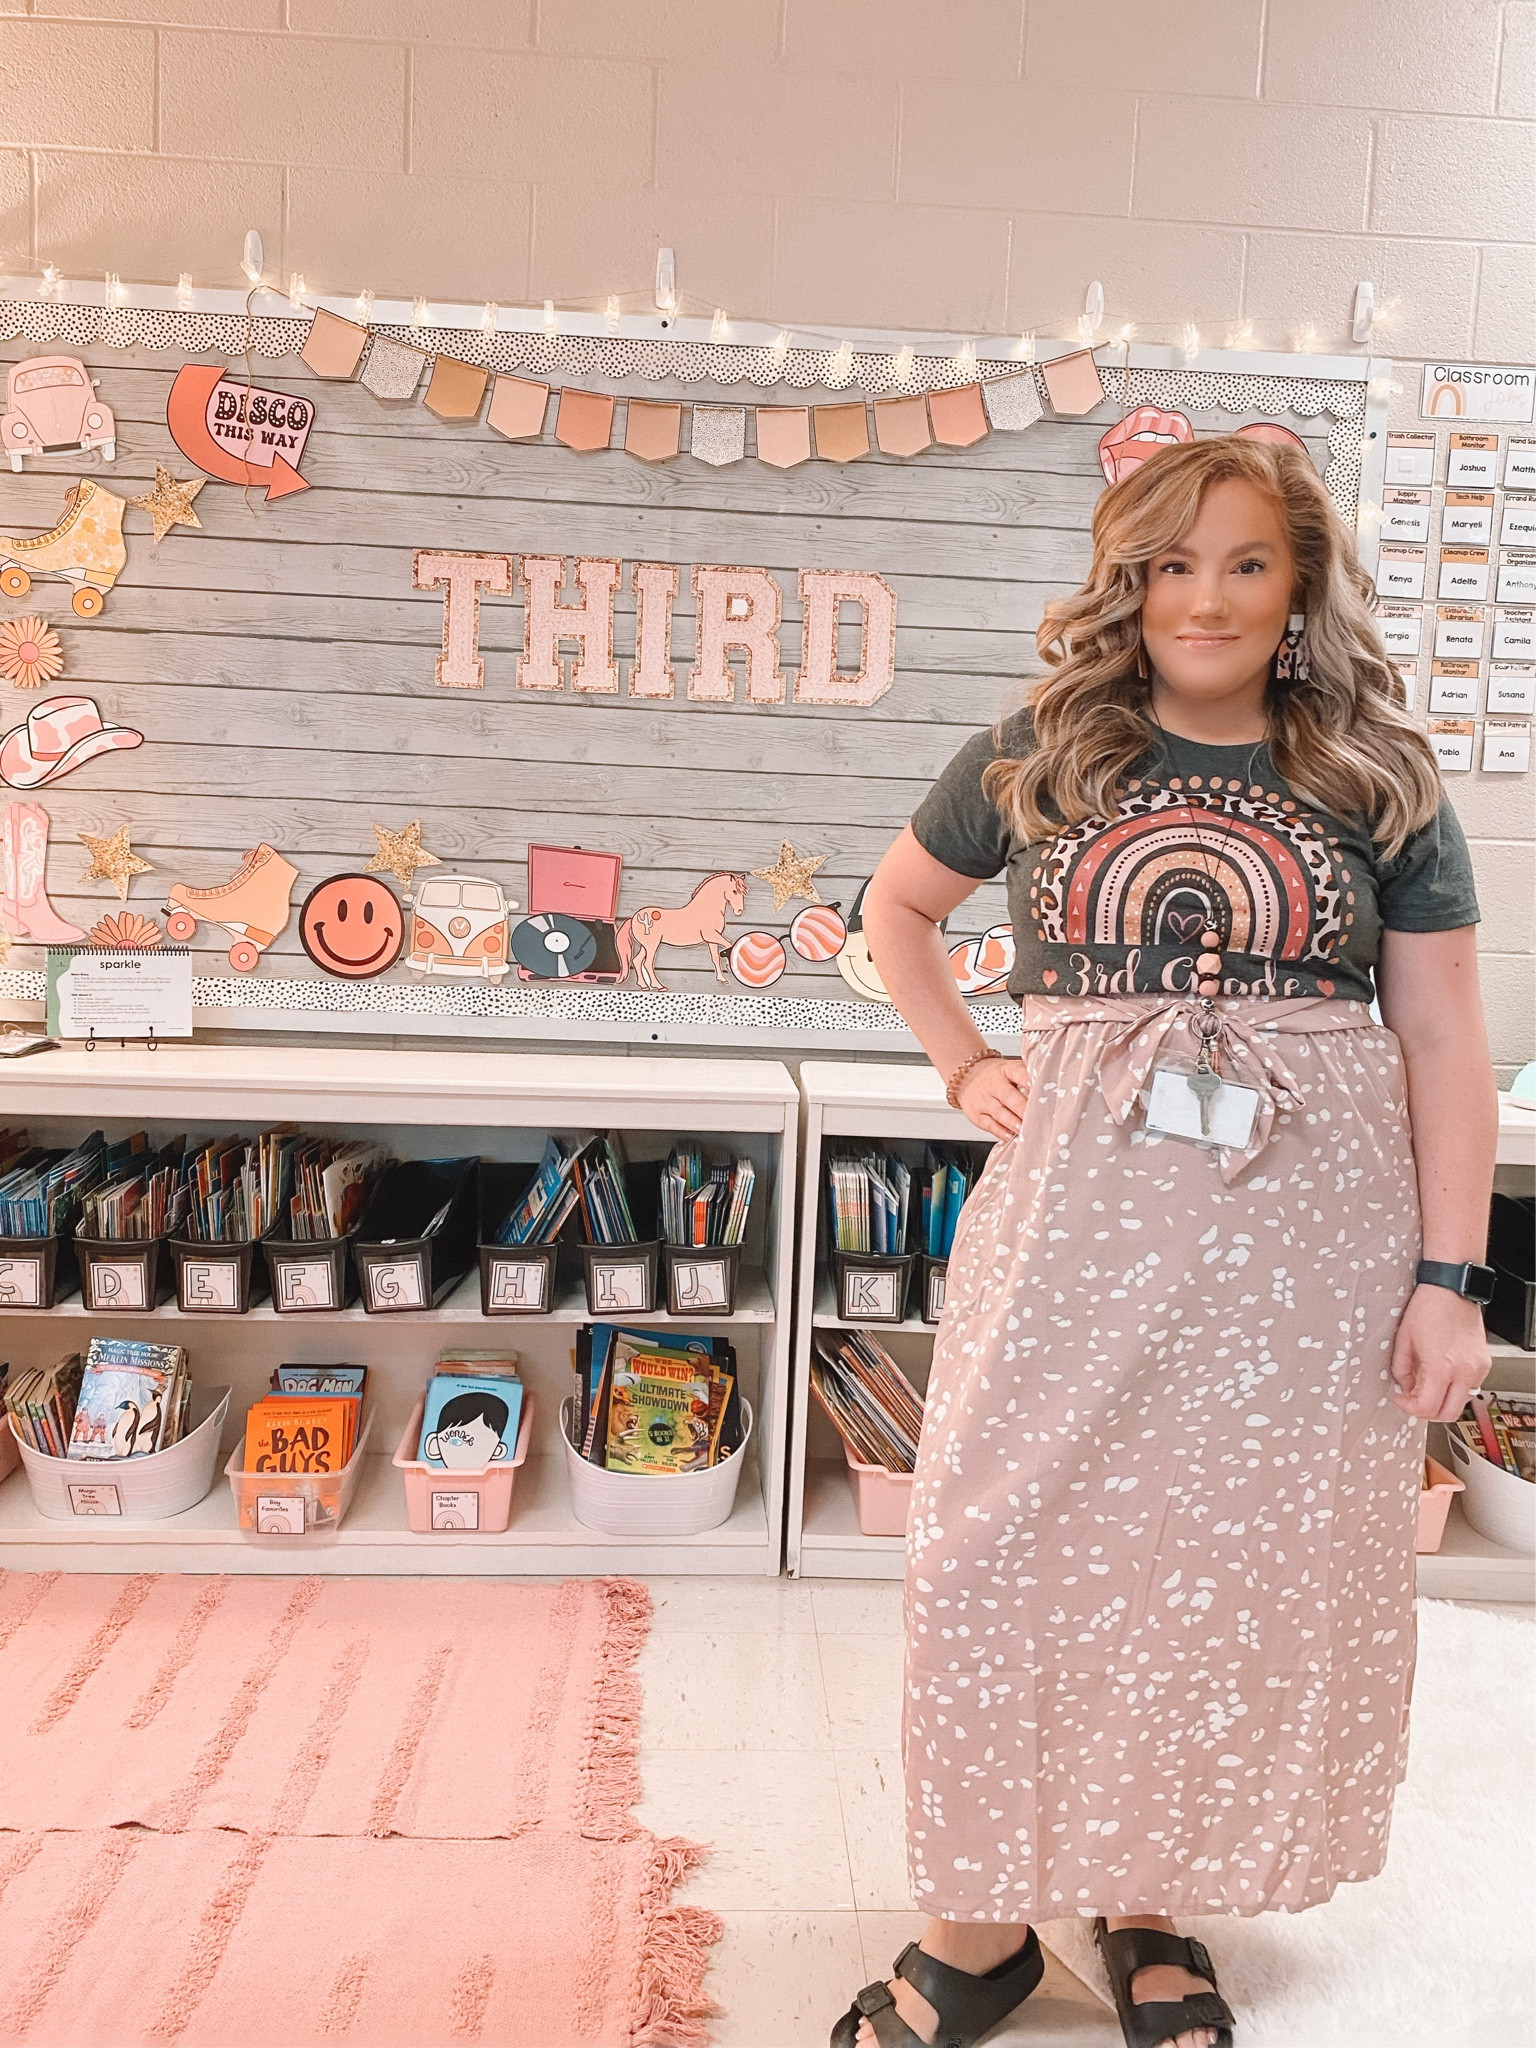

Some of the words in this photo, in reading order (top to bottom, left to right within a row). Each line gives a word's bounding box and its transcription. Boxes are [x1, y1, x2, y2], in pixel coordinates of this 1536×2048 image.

[1434, 366, 1529, 386] Classroom
[215, 391, 308, 431] DISCO
[214, 423, 254, 441] THIS
[261, 431, 299, 449] WAY
[1459, 464, 1486, 472] Joshua
[1390, 518, 1420, 527] Genesis
[1451, 521, 1482, 530] Maryeli
[1509, 523, 1536, 532] Ezequi
[1383, 547, 1407, 555] Cleanup
[1443, 549, 1467, 557] Cleanup
[1389, 575, 1413, 584] Kenya
[411, 548, 898, 706] THIRD
[1384, 632, 1410, 640] Sergio
[1446, 635, 1473, 643] Renata
[1441, 691, 1467, 699] Adrian
[1498, 691, 1525, 699] Susana
[100, 960, 141, 970] sparkle
[1067, 948, 1148, 996] 3rd
[1161, 956, 1307, 996] Gade
[97, 1267, 121, 1298] D
[190, 1268, 213, 1299] E
[284, 1267, 306, 1300] F
[375, 1268, 399, 1299] G
[496, 1267, 525, 1298] H
[599, 1269, 616, 1300] I
[681, 1267, 699, 1299] J
[852, 1277, 879, 1307] K
[98, 1353, 129, 1364] MERLIN
[130, 1356, 165, 1369] MISSIONS
[633, 1358, 667, 1376] WOULD
[668, 1367, 694, 1382] WIN?
[283, 1378, 318, 1392] DOG
[640, 1383, 686, 1399] ULTIMATE
[632, 1394, 689, 1412] SHOWDOWN
[258, 1439, 270, 1448] the
[271, 1426, 330, 1454] BAD
[256, 1451, 330, 1473] GUYS
